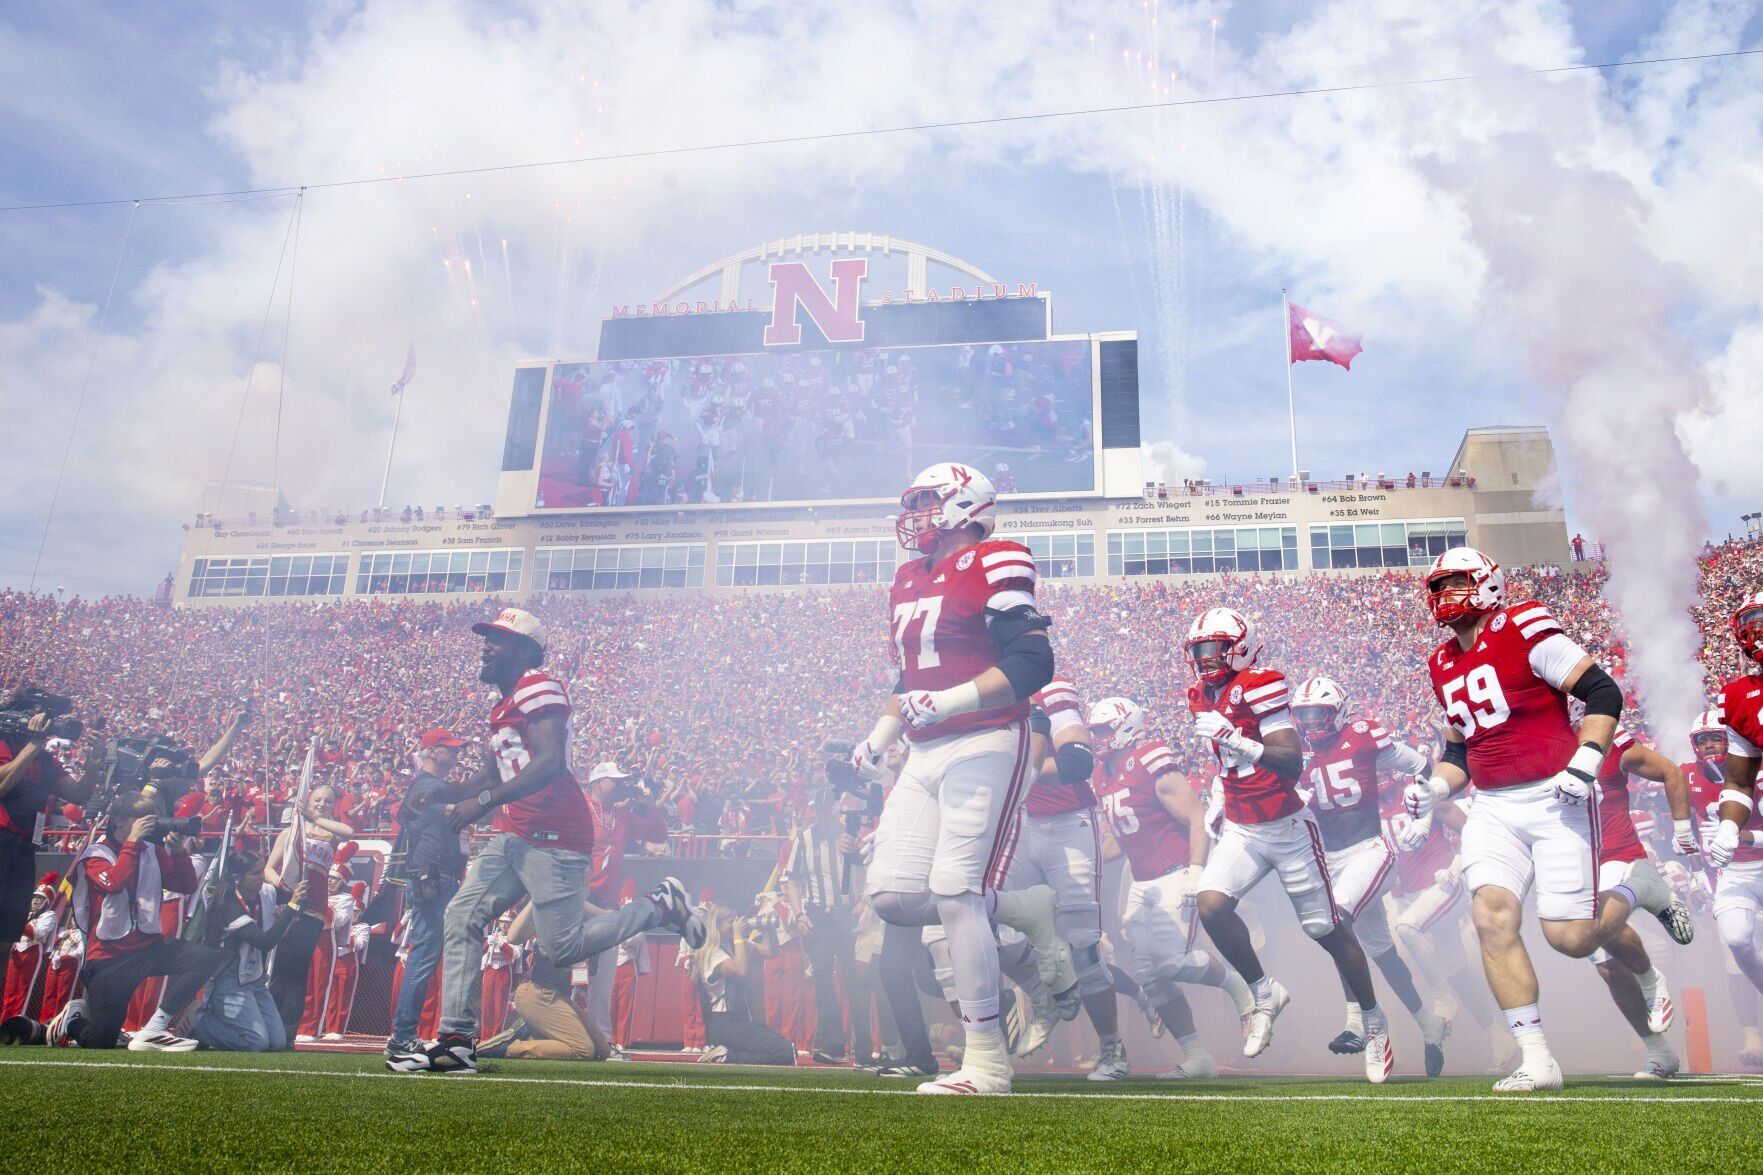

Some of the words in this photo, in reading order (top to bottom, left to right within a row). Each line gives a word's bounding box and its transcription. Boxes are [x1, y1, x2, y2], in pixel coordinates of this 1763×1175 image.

[611, 297, 757, 318] MEMORIAL
[881, 282, 1038, 305] STADIUM
[763, 257, 868, 346] N
[1204, 499, 1220, 507] #15
[1222, 498, 1258, 507] Tommie
[1260, 497, 1291, 506] Frazier
[1321, 495, 1337, 503] #64
[1339, 495, 1357, 503] Bob
[1359, 494, 1386, 502] Brown
[1031, 505, 1050, 513] Trev
[1052, 503, 1083, 512] Alberts
[1115, 502, 1131, 510] #72
[1133, 501, 1154, 510] Zach
[1157, 500, 1192, 509] Wiegert
[1205, 513, 1220, 521] #66
[1222, 512, 1253, 522] Wayne
[1255, 511, 1287, 521] Meylan
[1329, 509, 1345, 517] #35
[1346, 509, 1358, 517] Ed
[1360, 508, 1380, 516] Weir
[1002, 520, 1018, 528] #93
[1020, 519, 1075, 529] Ndamukong
[1076, 518, 1093, 526] Suh
[1118, 516, 1133, 524] #33
[1135, 515, 1164, 523] Forrest
[1166, 514, 1191, 523] Behm
[412, 524, 442, 534] Rodgers
[730, 528, 753, 537] Grant
[755, 528, 789, 536] Wistrom
[872, 525, 895, 534] Taylo
[213, 531, 228, 539] Guy
[555, 534, 580, 543] Bobby
[581, 532, 616, 542] Reynolds
[625, 532, 640, 540] #75
[641, 532, 663, 541] Larry
[664, 531, 703, 539] Jacobson
[499, 611, 517, 624] AHA
[892, 595, 944, 671] 77
[1442, 662, 1511, 740] 59
[1309, 758, 1362, 810] 15
[1101, 786, 1140, 838] 75
